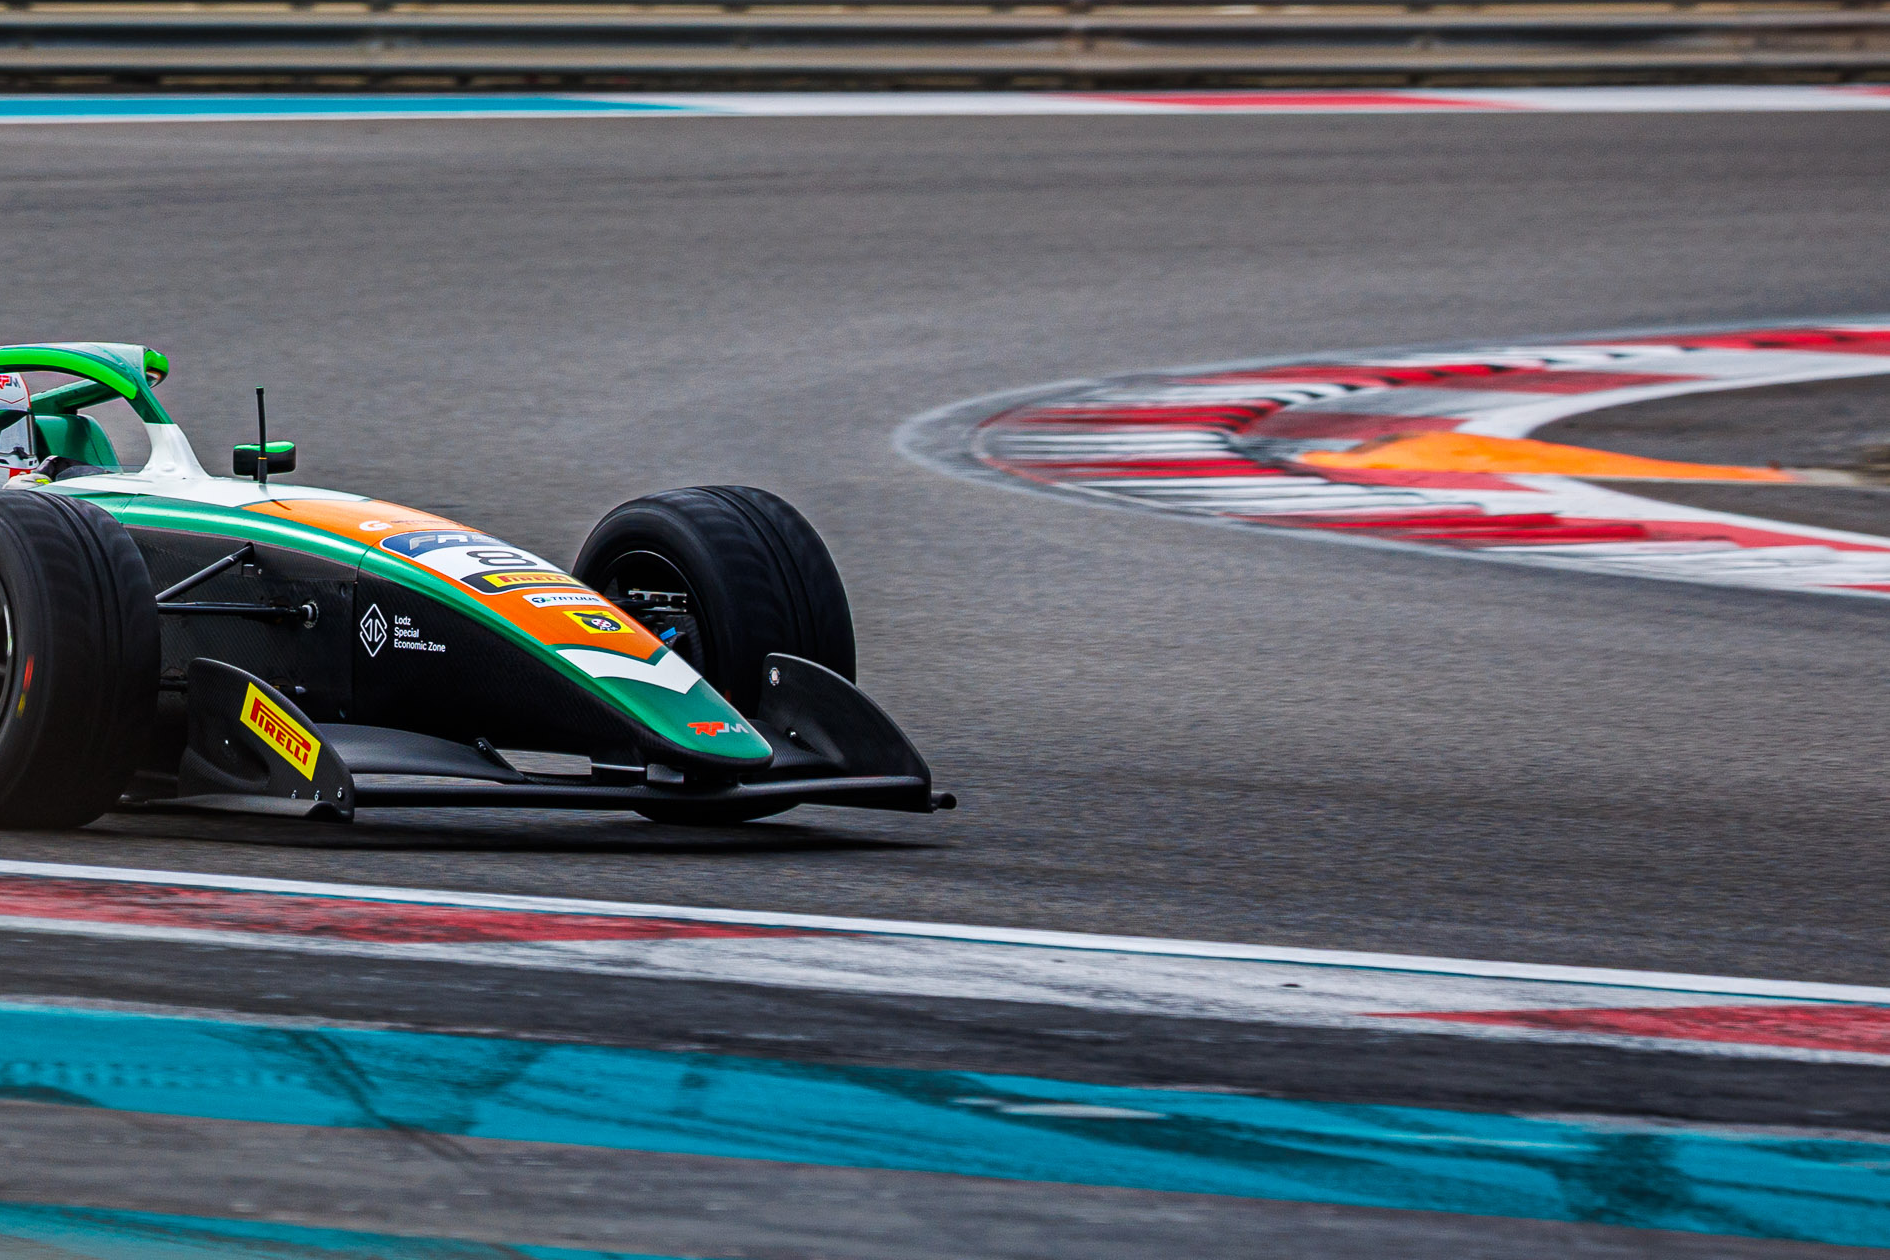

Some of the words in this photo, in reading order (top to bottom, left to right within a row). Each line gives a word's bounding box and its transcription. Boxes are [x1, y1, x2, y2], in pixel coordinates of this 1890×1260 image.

[466, 550, 538, 566] 8
[394, 615, 412, 626] Lodz
[394, 627, 420, 639] Special
[394, 639, 427, 651] Economic
[428, 641, 447, 653] Zone
[250, 697, 312, 767] PIRELLI
